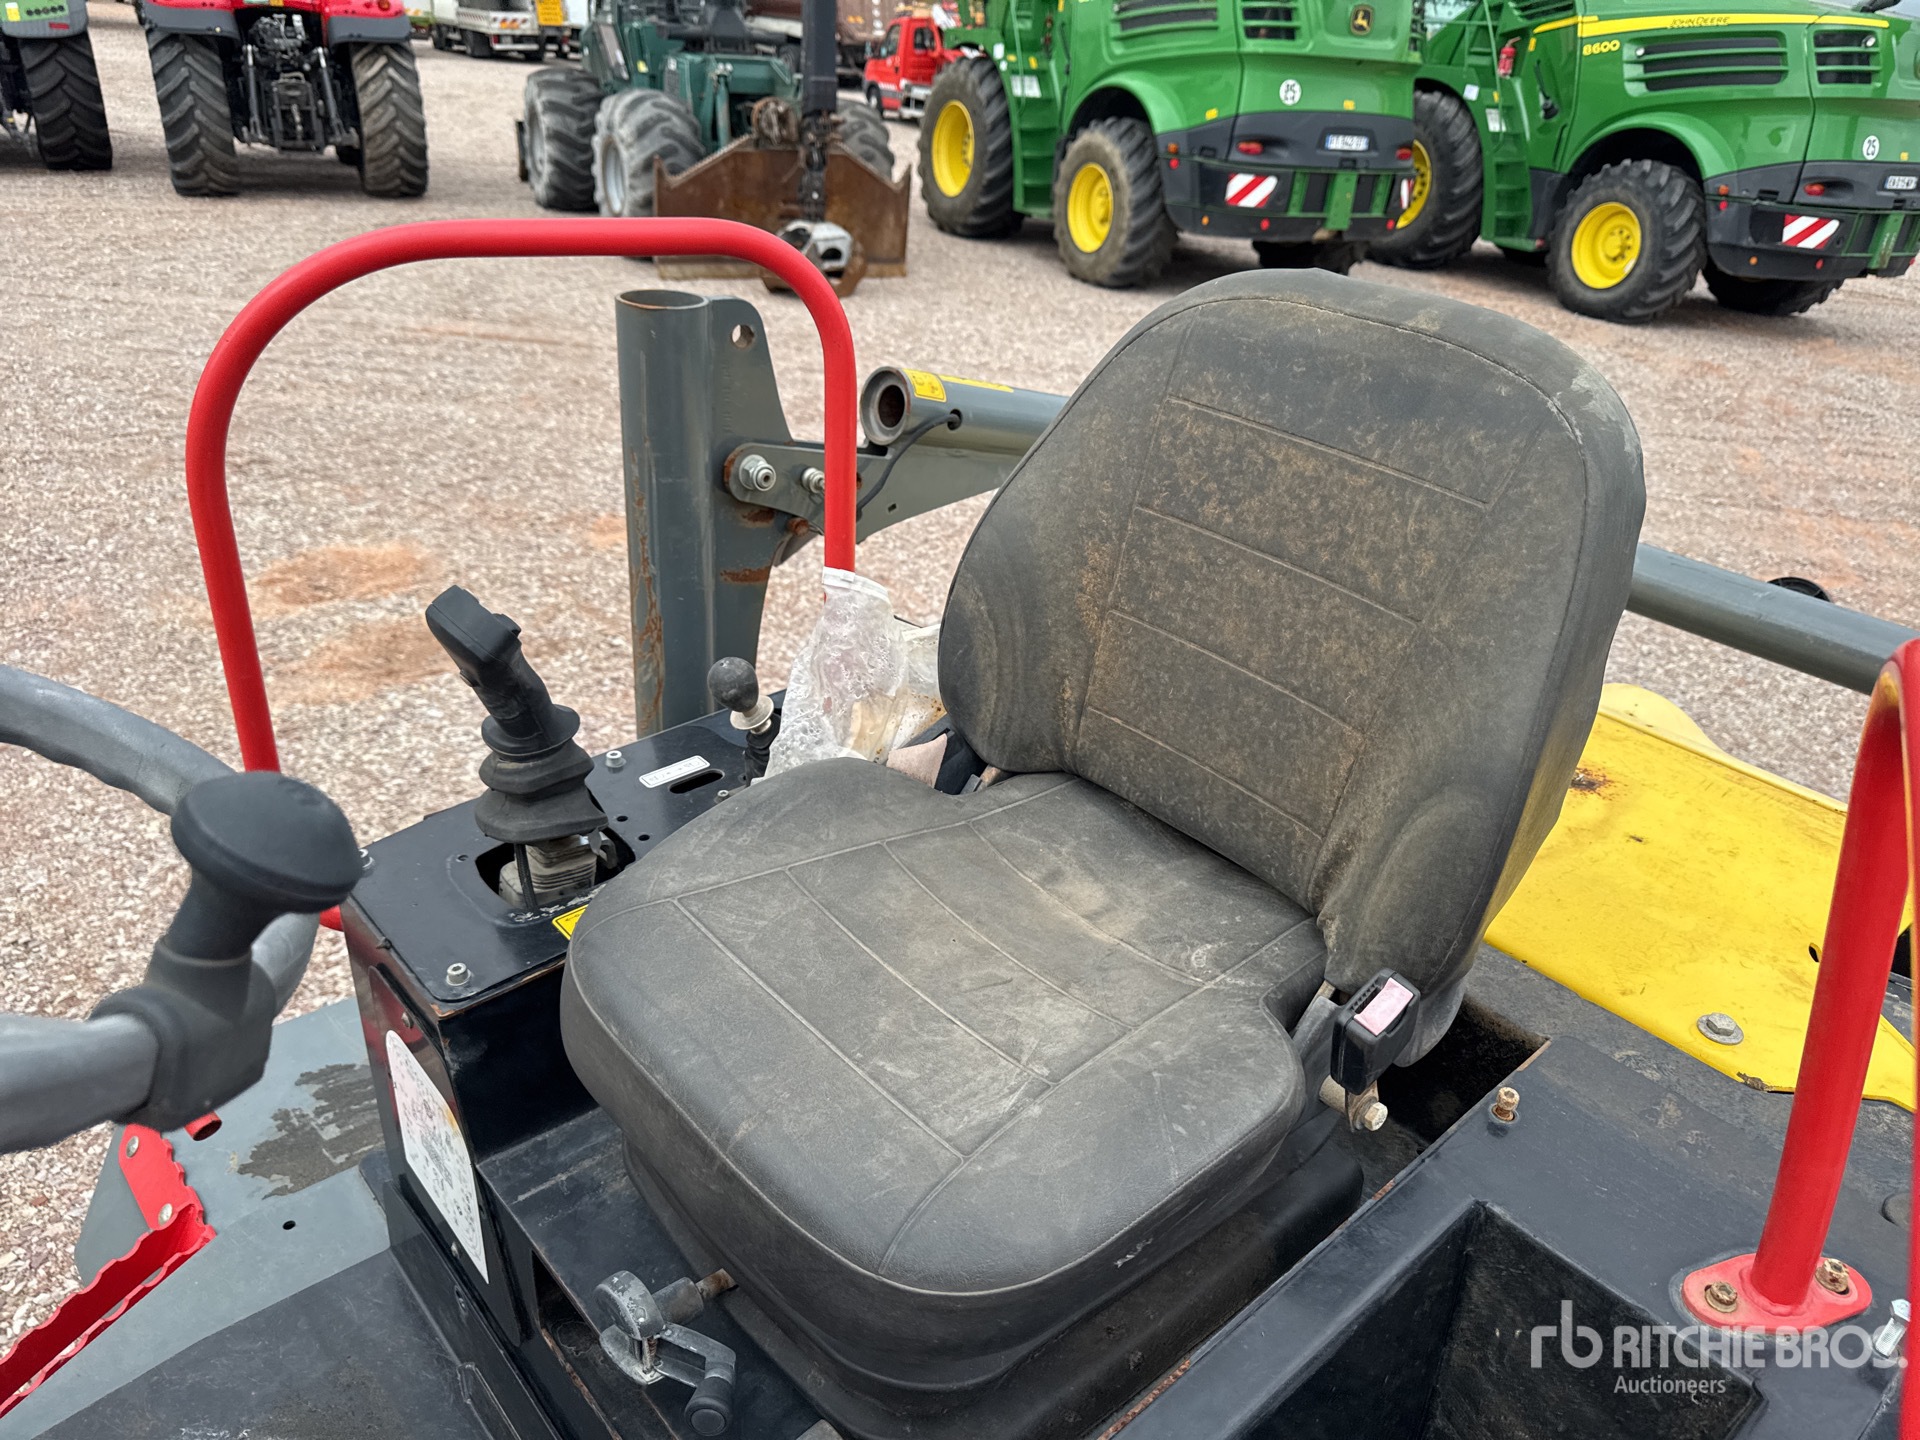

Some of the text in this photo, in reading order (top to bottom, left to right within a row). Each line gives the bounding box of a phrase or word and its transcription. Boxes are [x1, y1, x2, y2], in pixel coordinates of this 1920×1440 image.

[1696, 16, 1731, 26] DEERE
[1582, 39, 1621, 56] 8600
[1866, 139, 1876, 156] 25
